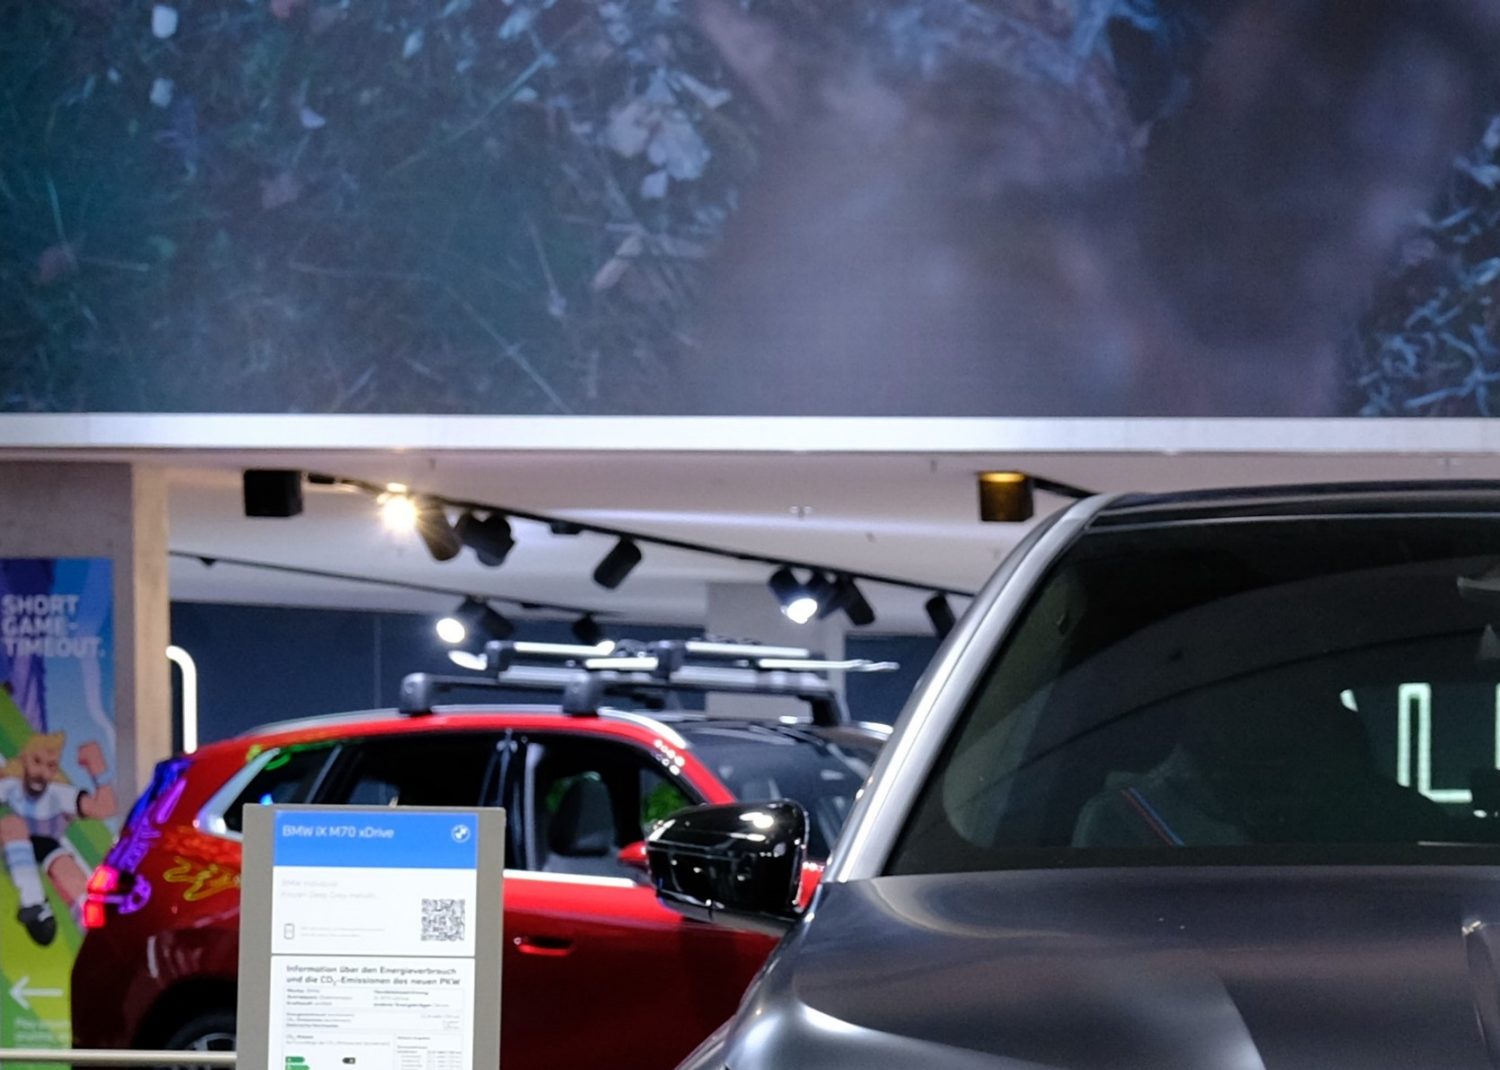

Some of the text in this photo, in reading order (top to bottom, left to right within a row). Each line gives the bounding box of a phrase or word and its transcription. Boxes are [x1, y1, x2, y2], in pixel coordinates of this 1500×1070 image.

[2, 594, 79, 616] SHORT
[2, 616, 79, 637] GAME-
[3, 636, 106, 658] TIMEOUT.
[282, 825, 395, 839] BMW iX M70 xDrive
[286, 965, 337, 973] Information
[379, 966, 457, 976] Energieverbrauch
